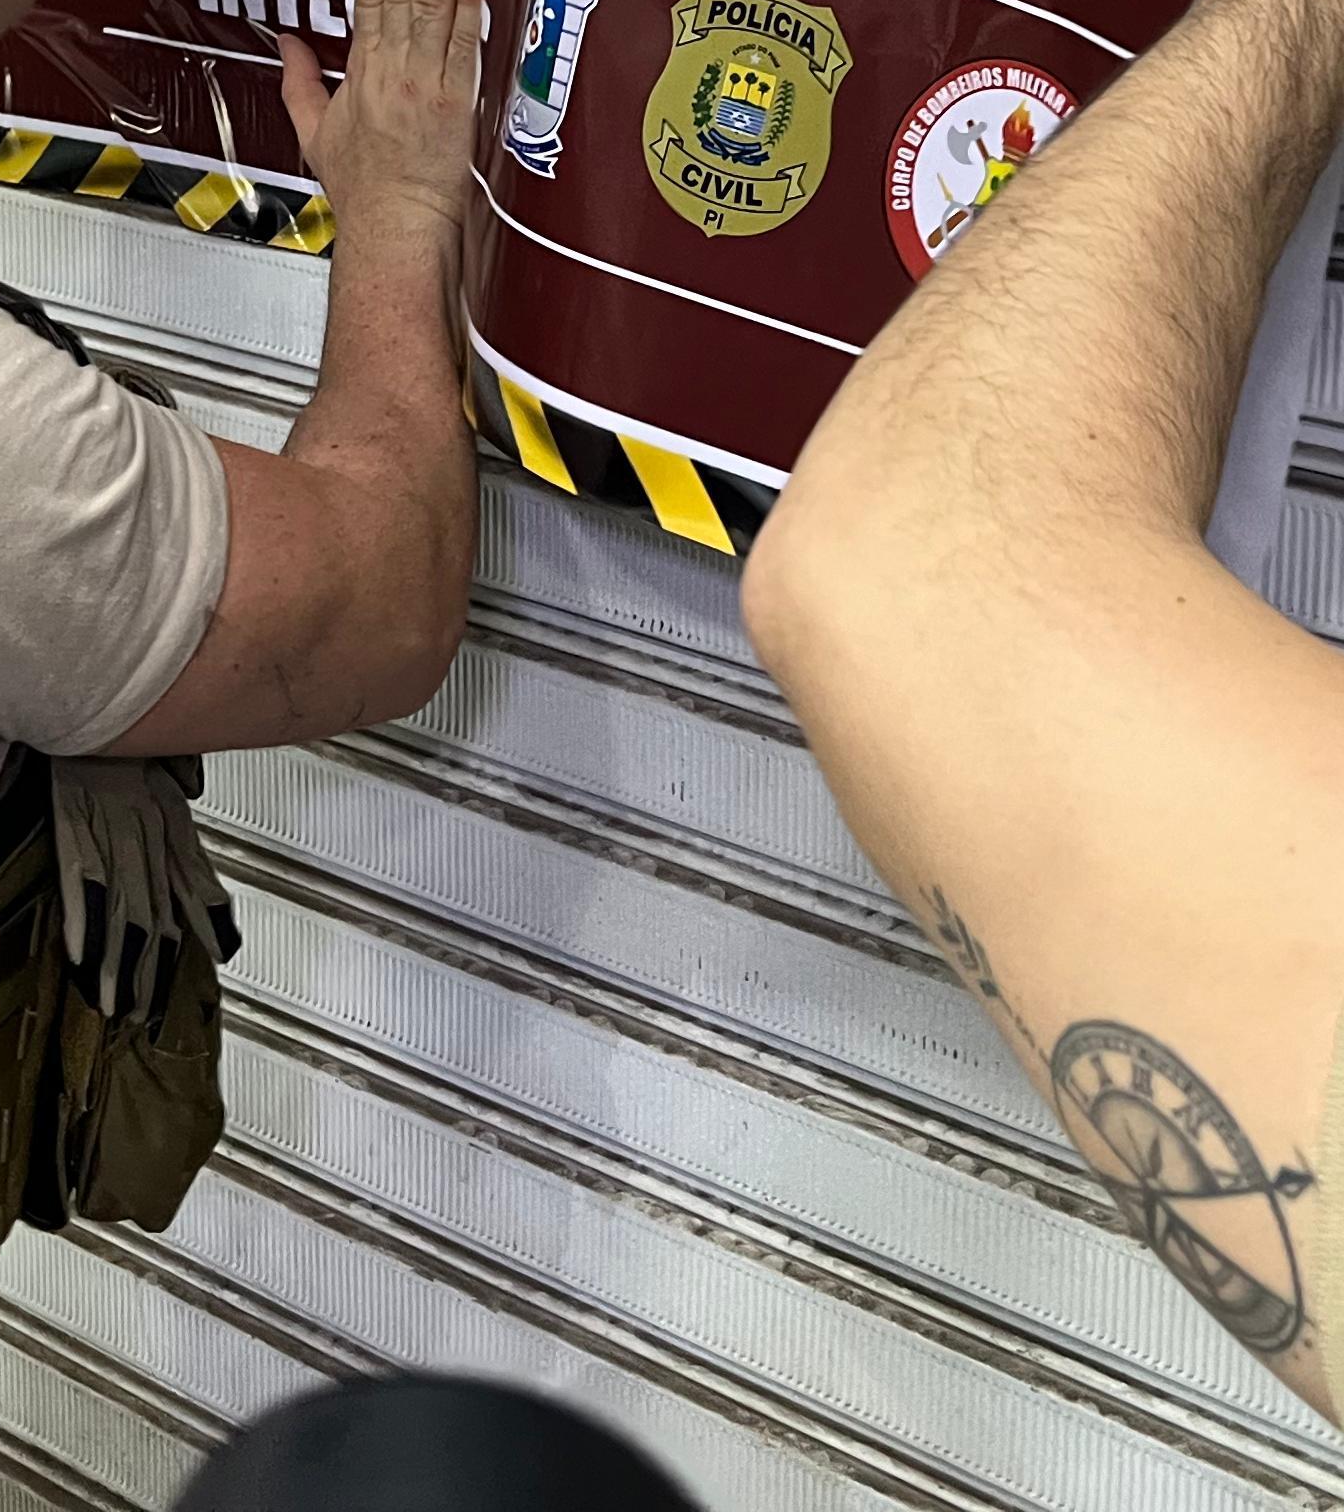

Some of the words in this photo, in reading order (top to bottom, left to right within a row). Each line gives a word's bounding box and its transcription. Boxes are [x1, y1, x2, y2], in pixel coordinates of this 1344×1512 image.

[707, 0, 816, 56] POLÍCIA
[916, 67, 1003, 126] BOMBEIROS
[1006, 67, 1067, 115] MILITAR
[902, 121, 928, 148] DE
[681, 163, 763, 207] CIVIL
[891, 146, 916, 211] CORPO
[703, 209, 724, 230] PI
